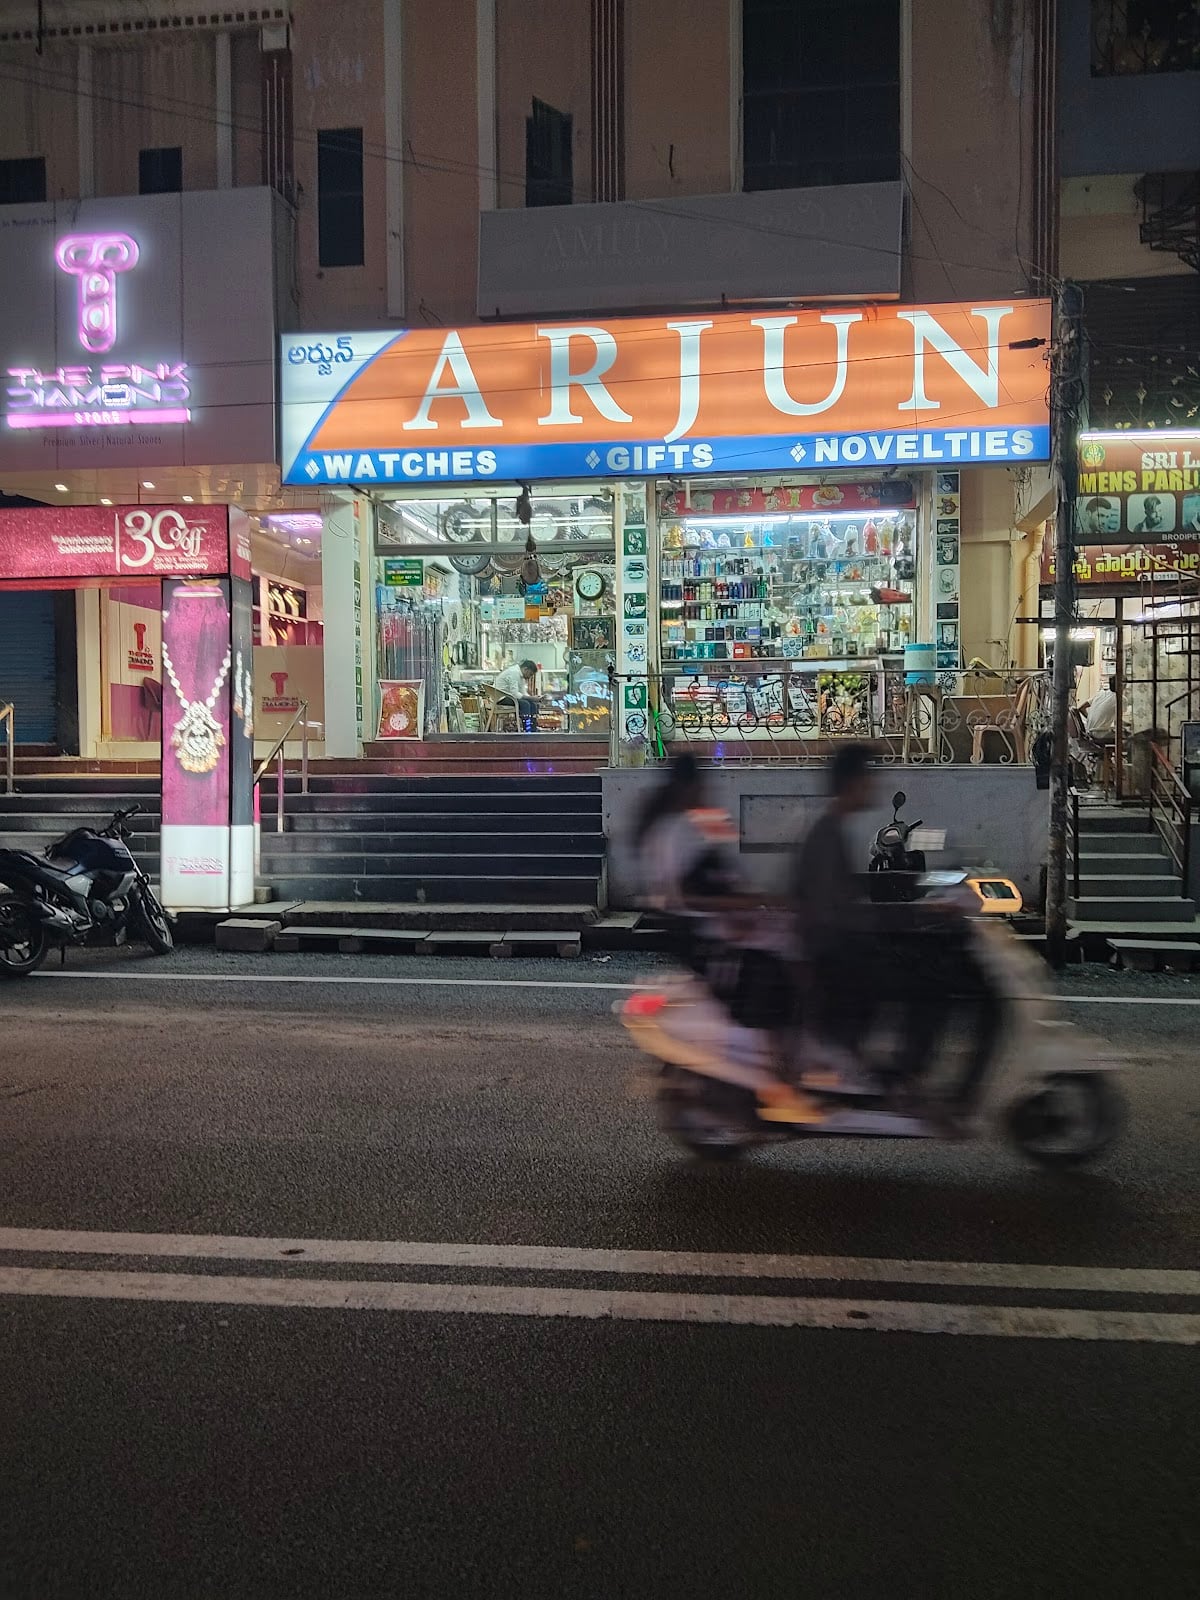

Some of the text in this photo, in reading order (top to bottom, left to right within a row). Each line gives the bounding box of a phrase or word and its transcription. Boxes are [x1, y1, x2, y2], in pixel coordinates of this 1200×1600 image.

[287, 335, 354, 376] అర్జున్
[7, 361, 190, 387] THE PINK
[402, 306, 1014, 443] ARJUN
[7, 380, 191, 408] DIAMOND
[74, 411, 121, 424] STORE
[43, 433, 162, 448] Premium Silver Natural Stones
[322, 430, 1034, 479] WATCHES GIFTS NOVELTIES
[1141, 451, 1178, 469] SRI
[1079, 470, 1137, 494] MENS
